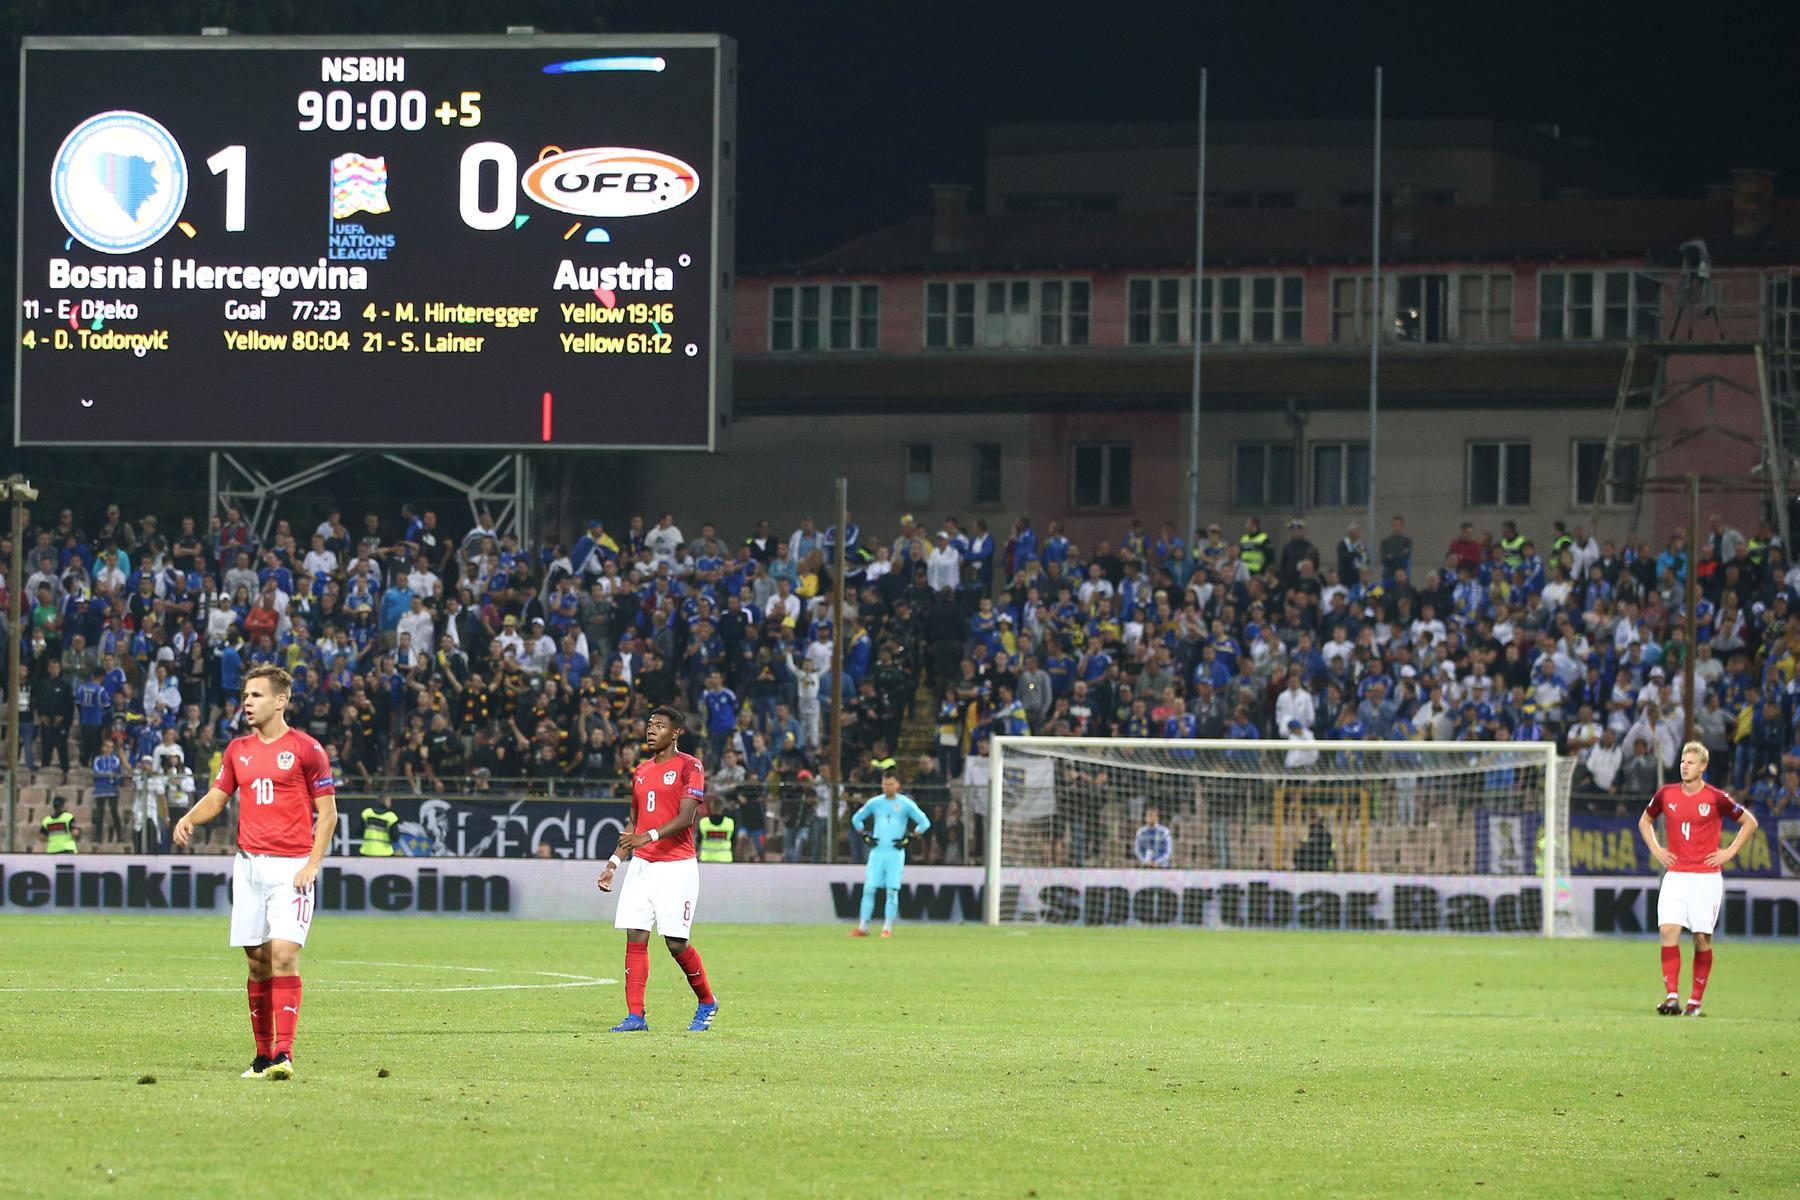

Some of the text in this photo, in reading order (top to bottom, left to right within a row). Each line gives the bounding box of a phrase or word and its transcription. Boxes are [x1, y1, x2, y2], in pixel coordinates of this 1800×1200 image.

[322, 57, 404, 82] NSBIH
[298, 90, 481, 131] 90:00 +5
[207, 145, 246, 232] 1
[459, 141, 517, 231] 0
[336, 224, 365, 234] UEFA
[329, 235, 396, 247] NATIONS
[329, 248, 388, 259] LEAGUE
[49, 257, 367, 297] Bosna i Hercegovina
[553, 258, 674, 290] Austria
[22, 300, 39, 319] 11
[58, 300, 77, 319] E.
[82, 299, 139, 320] Džeko
[225, 300, 341, 320] Goal 77:23
[363, 303, 377, 322] 4
[395, 303, 419, 322] M.
[425, 303, 538, 327] Hinteregger
[560, 303, 674, 323] Yellow 19:16
[22, 329, 36, 350] 4
[55, 328, 74, 349] D.
[79, 329, 169, 350] Todorović
[224, 330, 350, 350] Yellow 80:04
[363, 332, 382, 352] 21
[401, 332, 419, 352] S.
[425, 332, 484, 352] Lainer
[560, 333, 673, 354] Yellow 61:12
[251, 778, 274, 805] 10
[646, 790, 656, 812] 8
[1681, 822, 1691, 841] 4
[0, 863, 510, 911] einkirheim
[292, 897, 310, 923] 10
[683, 900, 690, 921] 8
[1594, 887, 1800, 935] Klin
